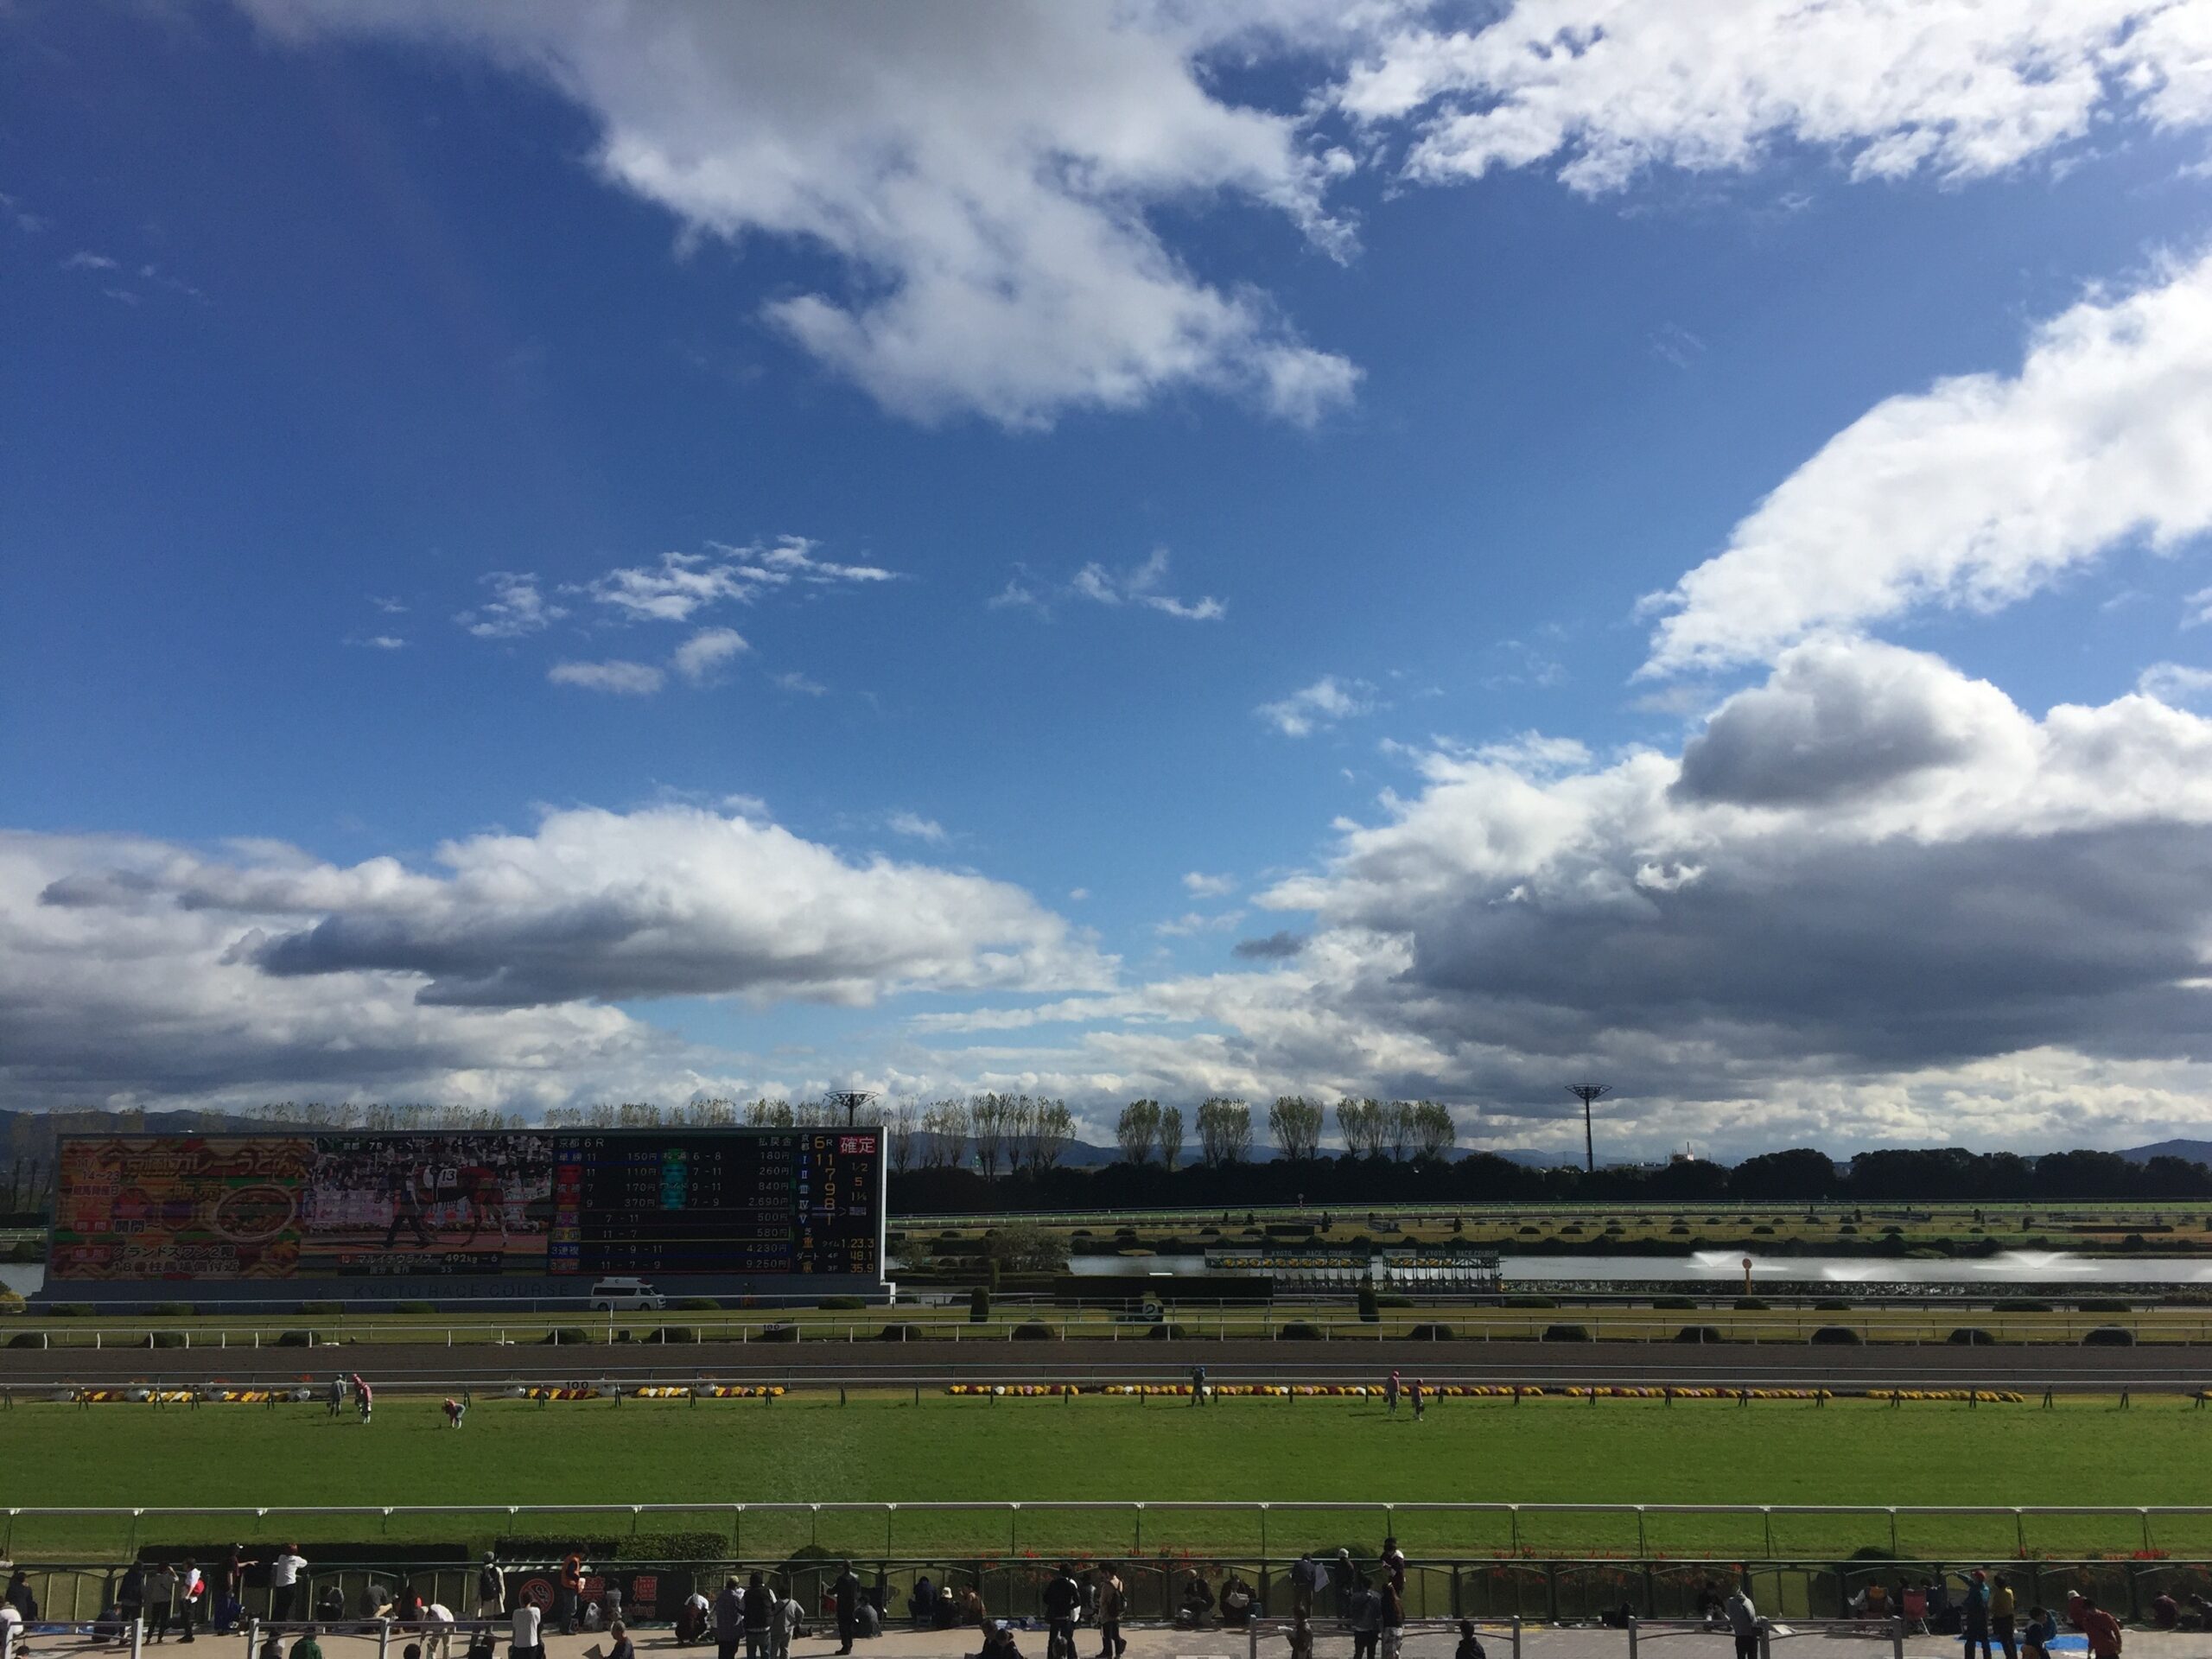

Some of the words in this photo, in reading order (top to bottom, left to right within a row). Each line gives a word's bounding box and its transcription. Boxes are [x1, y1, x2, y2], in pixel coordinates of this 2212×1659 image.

[559, 1138, 580, 1147] 京都
[759, 1137, 792, 1147] 払戻金
[841, 1137, 875, 1154] 確定
[588, 1153, 596, 1161] 11
[628, 1153, 657, 1161] 150円
[760, 1151, 790, 1160] 180円
[442, 1170, 455, 1182] 13
[760, 1167, 790, 1176] 260円
[825, 1168, 836, 1181] 7
[759, 1182, 789, 1191] 840円
[855, 1177, 863, 1187] 5
[588, 1184, 594, 1192] 7
[626, 1184, 656, 1192] 170円
[824, 1183, 836, 1196] 9
[587, 1199, 594, 1208] 9
[624, 1198, 655, 1207] 370円
[824, 1197, 836, 1211] 8
[758, 1212, 788, 1222] 500円
[757, 1228, 787, 1236] 580円
[444, 1254, 478, 1264] 492kg
[796, 1251, 821, 1262] ダート
[849, 1262, 874, 1273] 35.9
[353, 1284, 420, 1297] KYOTO
[429, 1284, 483, 1297] RACE
[489, 1283, 569, 1297] COURSE
[1146, 1304, 1156, 1315] 2
[565, 1381, 588, 1389] 100
